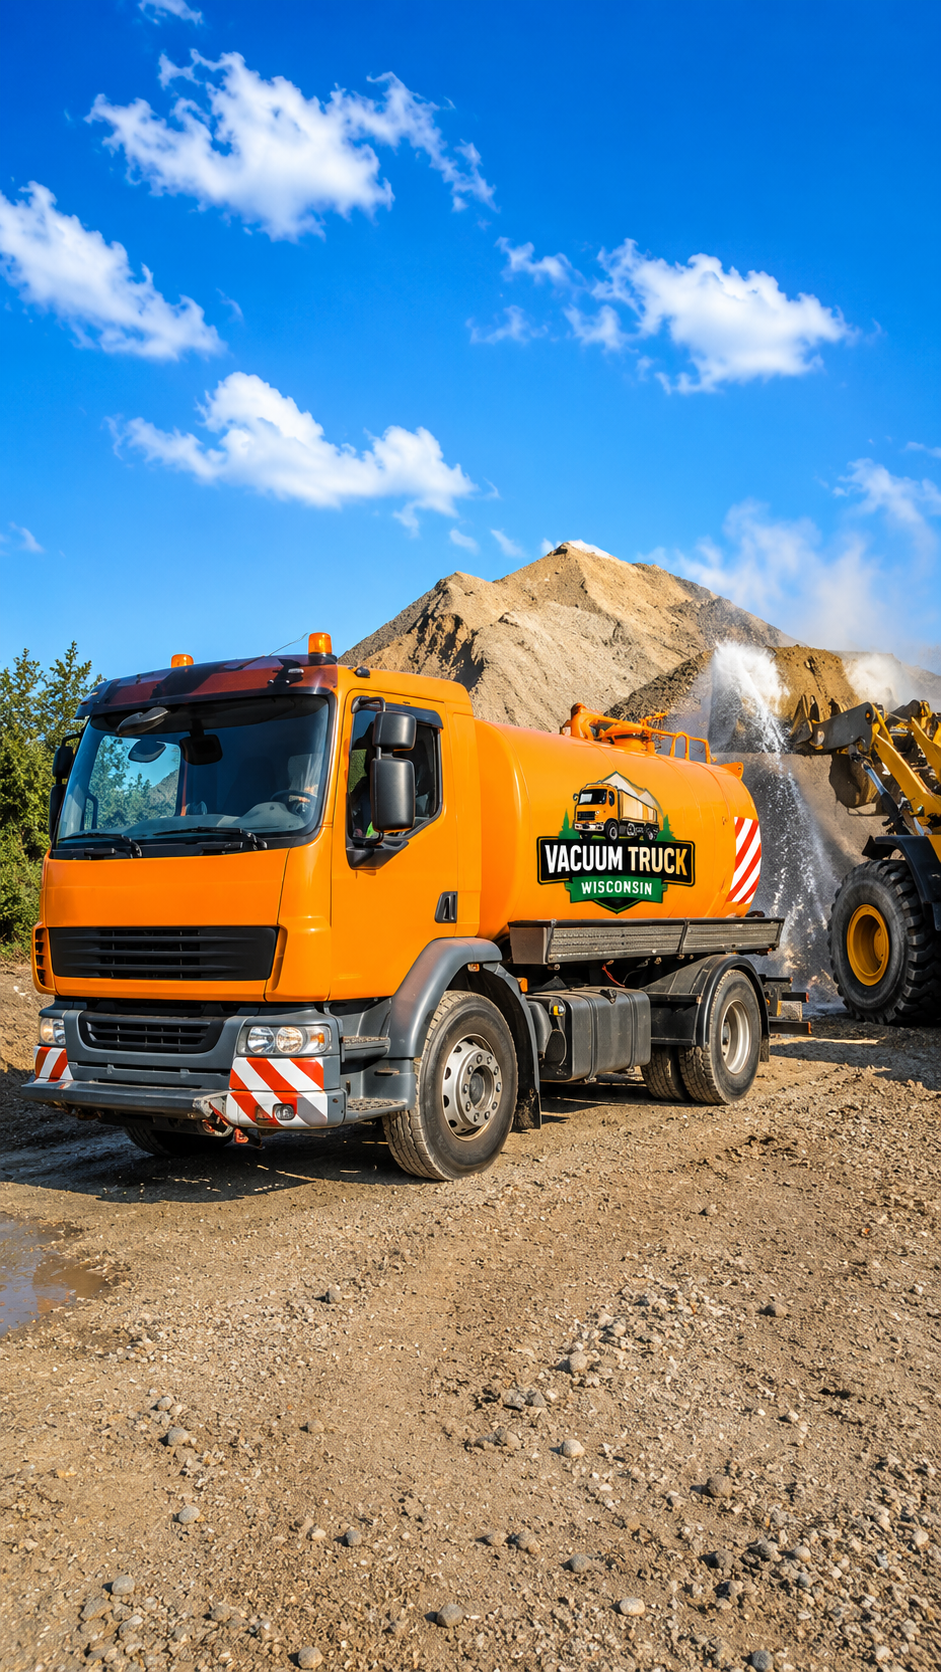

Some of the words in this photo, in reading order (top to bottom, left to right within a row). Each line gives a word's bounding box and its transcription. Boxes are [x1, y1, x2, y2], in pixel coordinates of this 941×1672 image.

[544, 844, 623, 873] VACUUM
[628, 846, 688, 876] TRUCK
[581, 880, 652, 895] WISCONSIN
